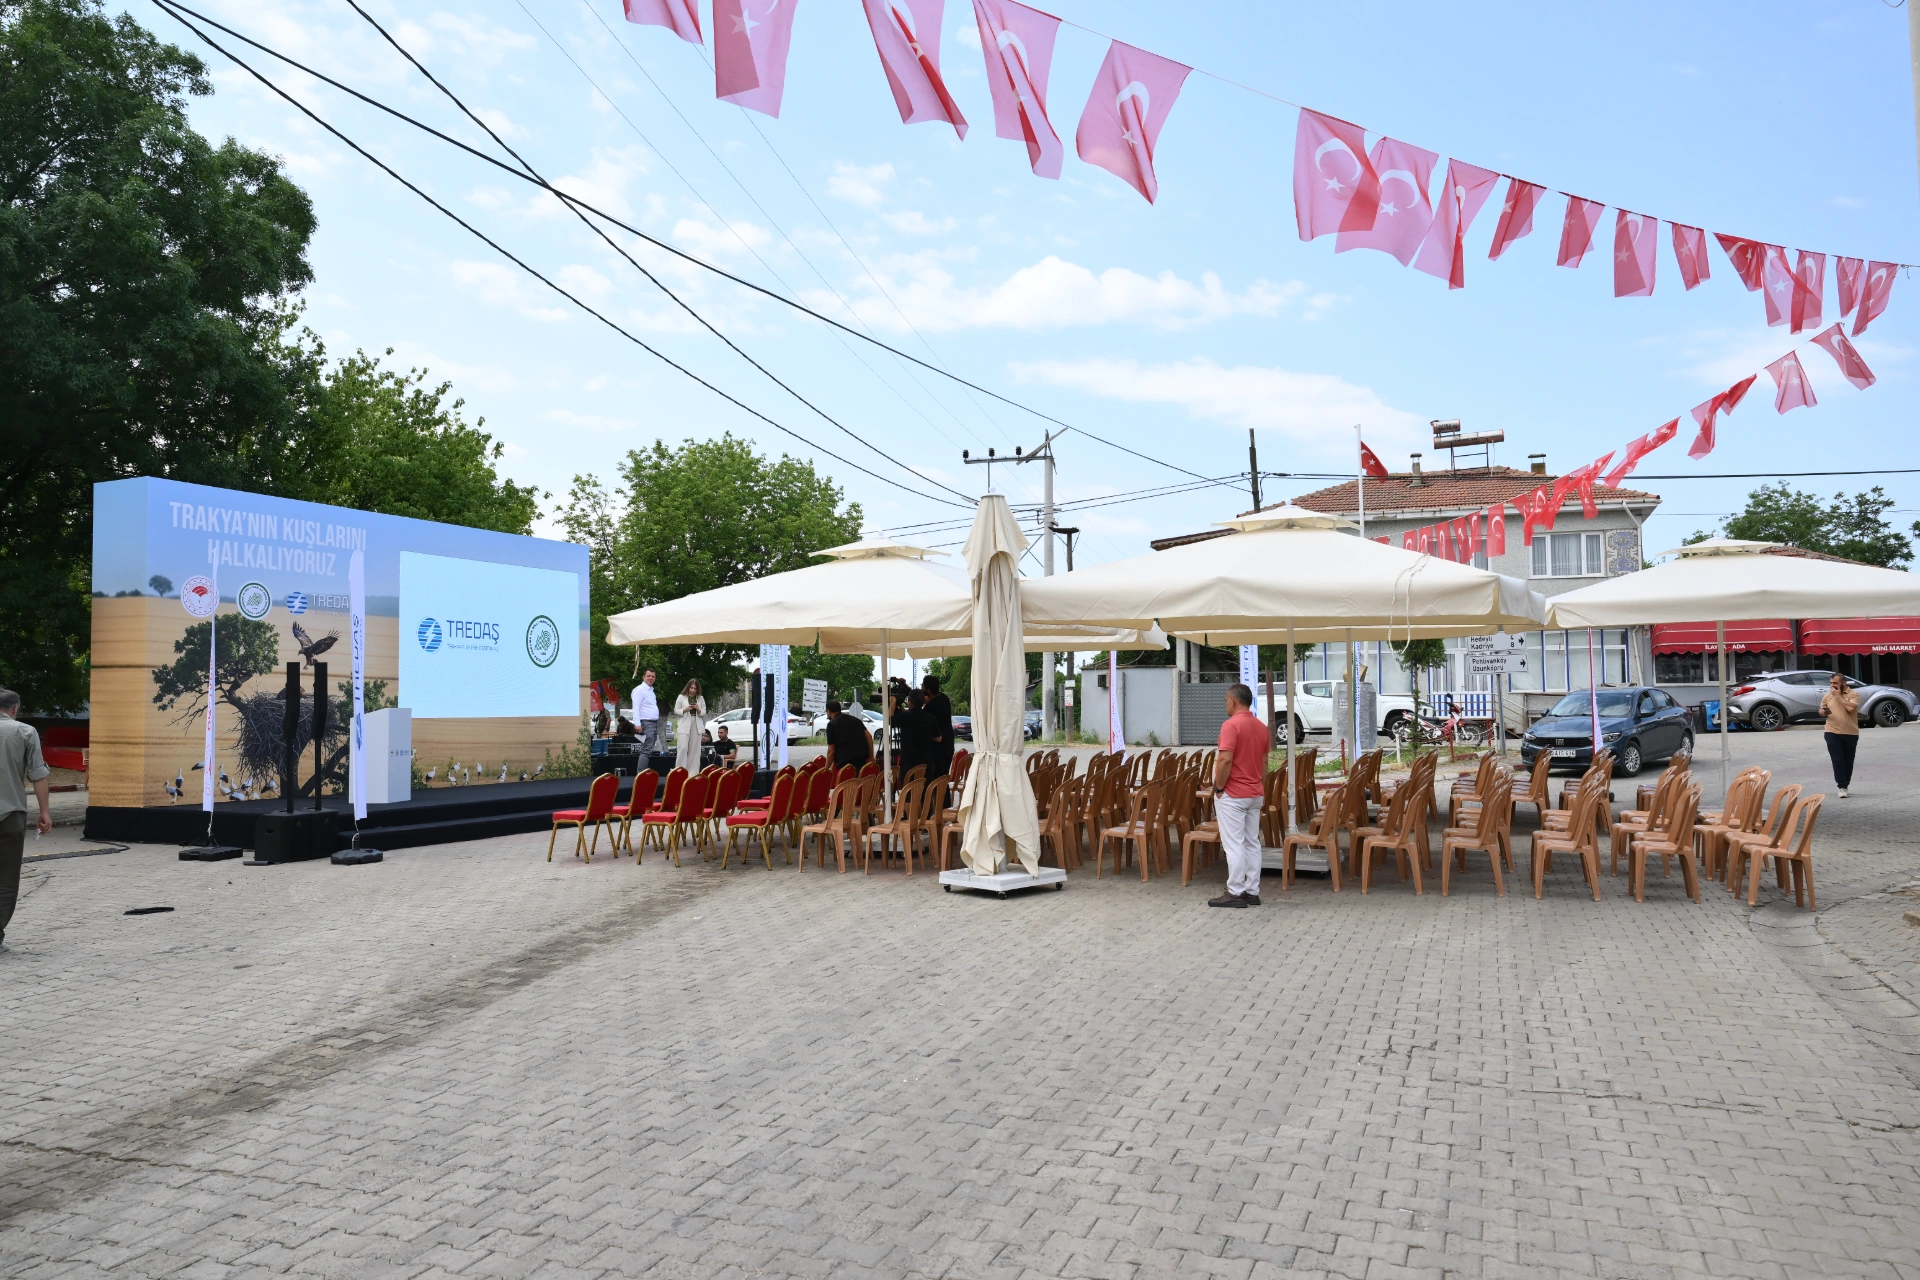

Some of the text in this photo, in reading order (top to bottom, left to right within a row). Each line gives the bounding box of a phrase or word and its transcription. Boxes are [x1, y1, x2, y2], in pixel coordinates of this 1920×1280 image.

[169, 501, 367, 552] TRAKYA'NIN KUŞLARINI
[207, 538, 337, 577] HALKALIYORUZ
[310, 593, 350, 609] TREDA
[446, 619, 500, 645] TREDAŞ
